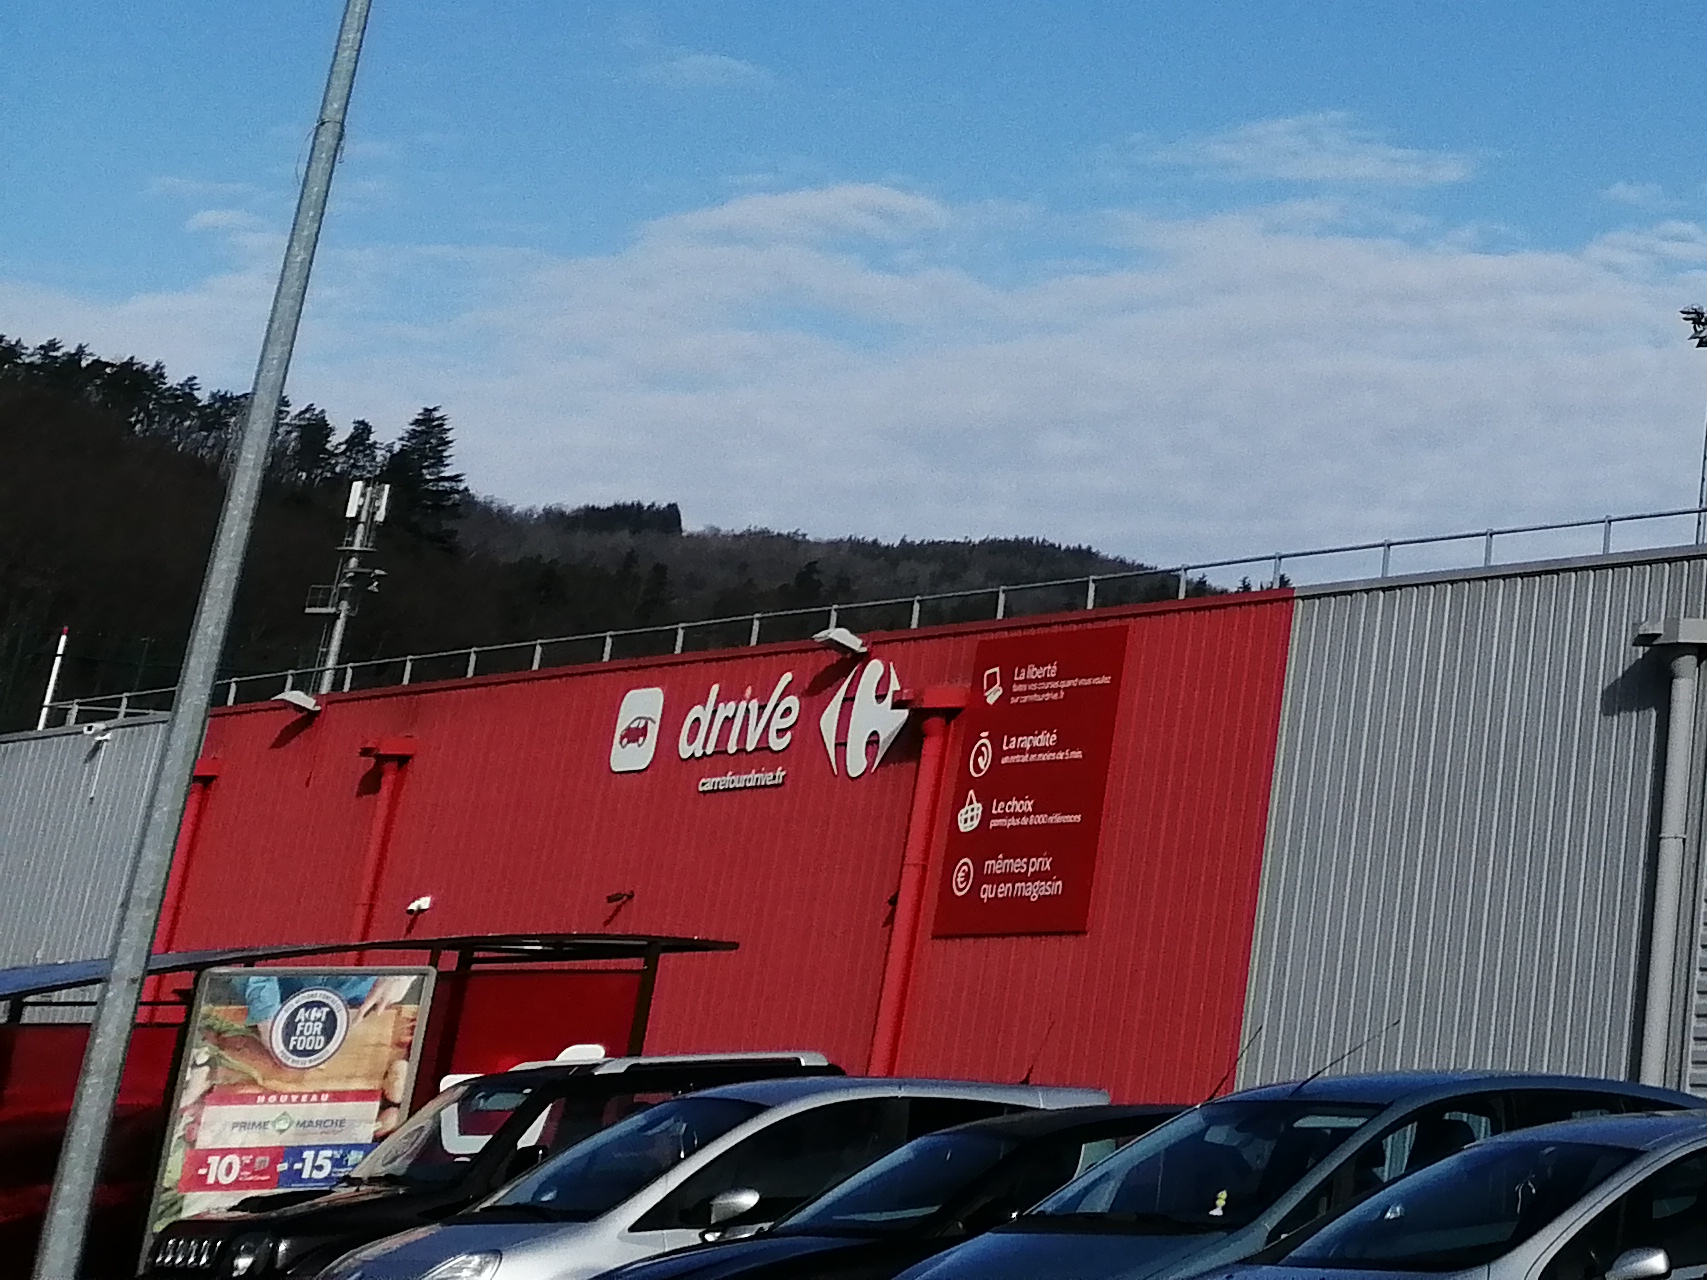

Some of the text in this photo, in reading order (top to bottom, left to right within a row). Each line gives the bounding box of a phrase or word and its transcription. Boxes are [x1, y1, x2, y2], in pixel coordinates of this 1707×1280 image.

[1014, 661, 1058, 681] La liberté
[678, 671, 800, 760] drive
[1002, 729, 1057, 751] La rapidité
[698, 767, 786, 792] carrefourdrive.fr
[991, 795, 1034, 814] Le choix
[983, 851, 1053, 877] mêmes prix
[1013, 876, 1063, 901] magasin
[295, 1022, 323, 1036] FOR
[288, 1035, 325, 1051] FOOD
[256, 1093, 330, 1104] NOUVEAU
[231, 1120, 271, 1132] PRIME
